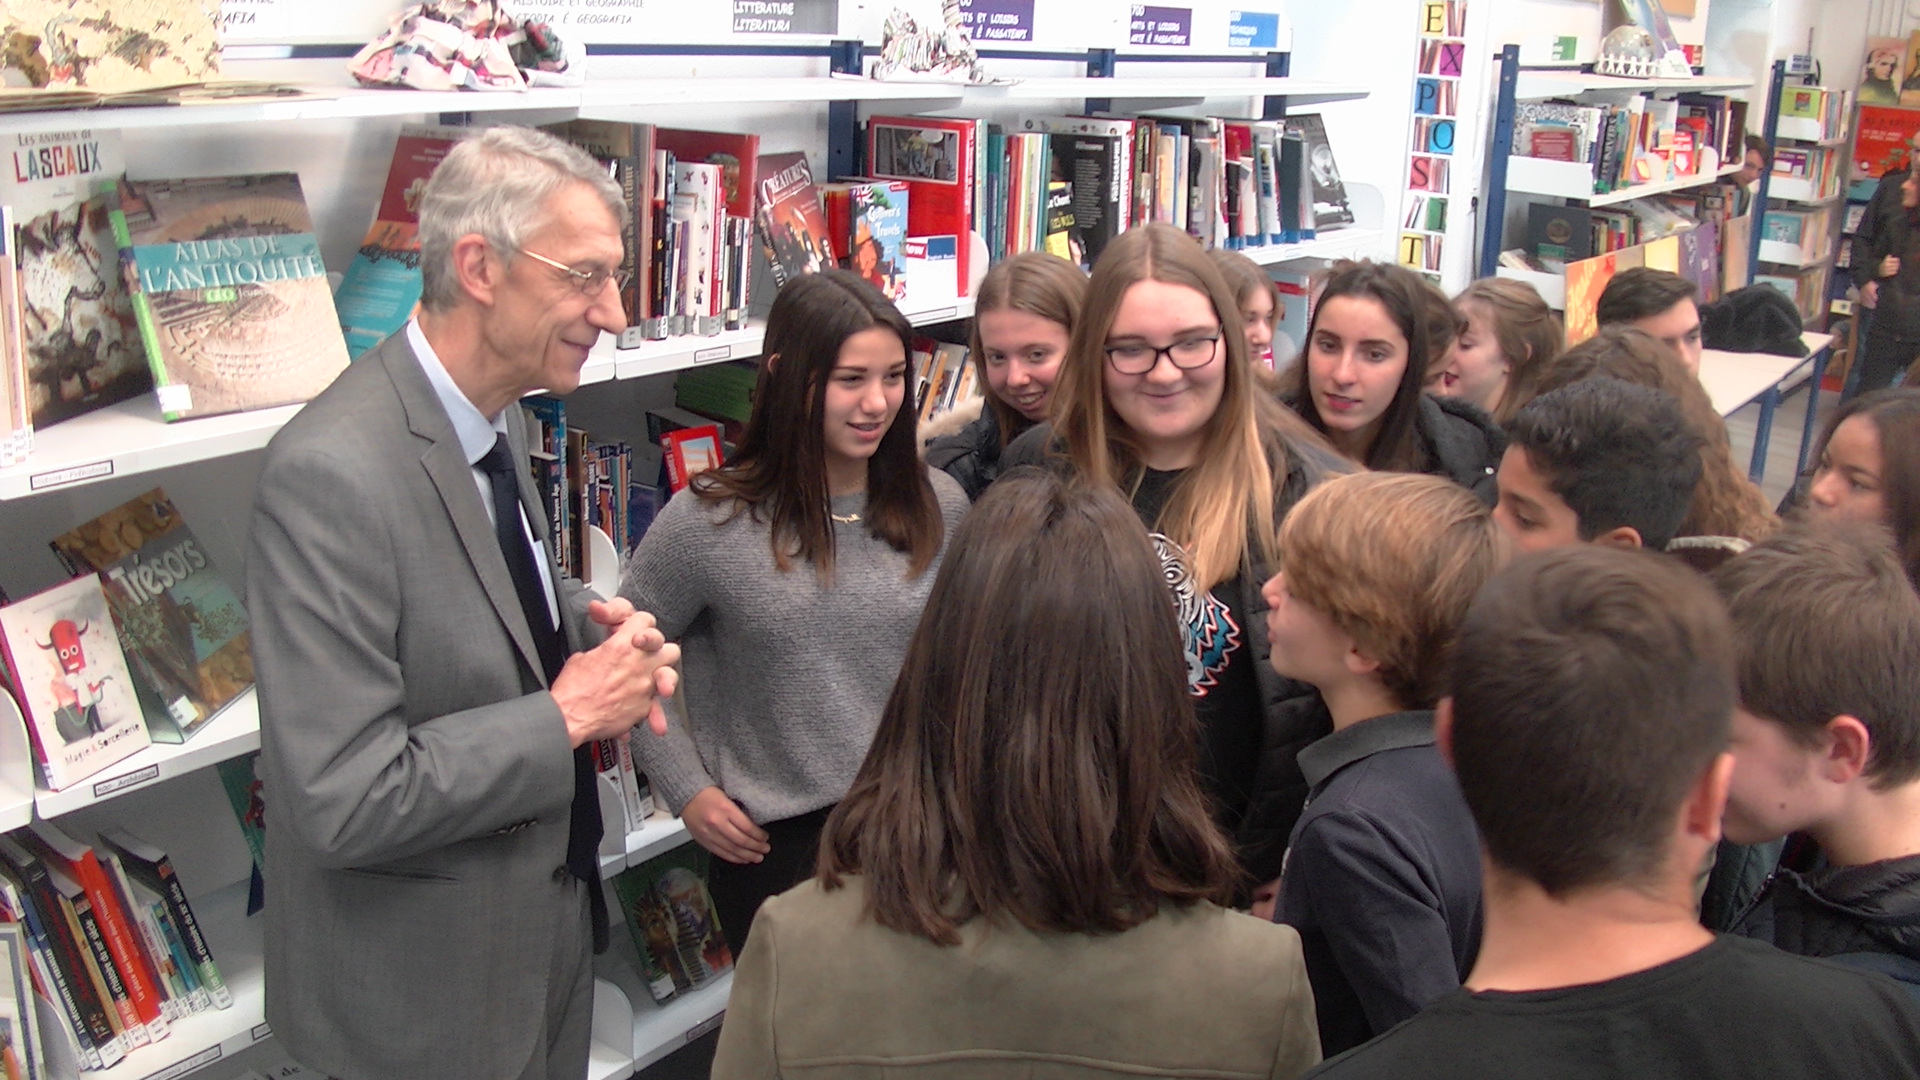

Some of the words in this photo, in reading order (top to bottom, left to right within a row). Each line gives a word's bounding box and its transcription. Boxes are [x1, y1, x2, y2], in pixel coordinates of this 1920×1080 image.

[577, 13, 632, 24] GEOGRAFIA
[734, 18, 791, 32] LITERATURA
[976, 12, 988, 23] ET
[14, 141, 102, 184] LASCAUX
[175, 237, 243, 262] ATLAS
[251, 235, 281, 256] DE
[144, 248, 324, 293] L'ANTIQUITÉ
[108, 540, 206, 606] Trésors
[65, 749, 90, 767] Magie
[97, 723, 141, 750] Sorcellerie
[600, 738, 612, 770] HISTO
[621, 743, 634, 773] Histo
[168, 881, 185, 903] siècle
[83, 917, 100, 941] siècle
[182, 913, 194, 926] du
[112, 935, 130, 963] femmes
[187, 924, 207, 956] d'histoire
[97, 950, 110, 963] du
[123, 961, 135, 974] des
[200, 954, 217, 977] fiches
[102, 961, 123, 994] d'histoire
[128, 972, 143, 992] place
[209, 975, 223, 990] 100
[115, 991, 132, 1014] fiches
[125, 1012, 138, 1027] 100
